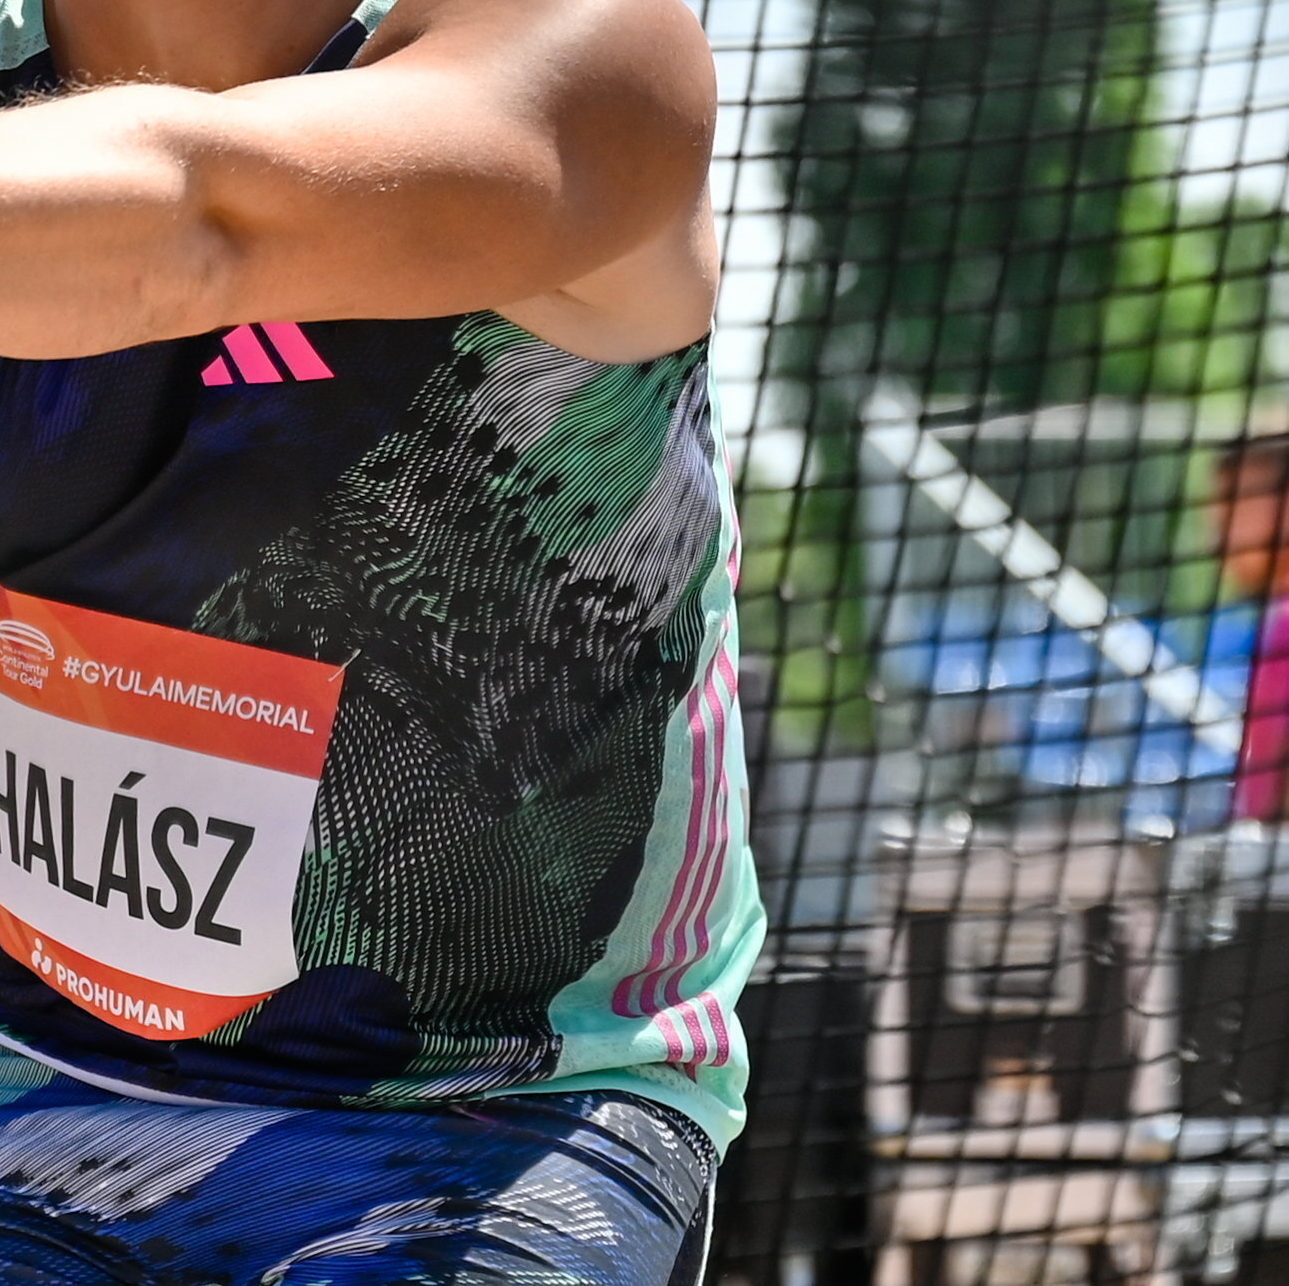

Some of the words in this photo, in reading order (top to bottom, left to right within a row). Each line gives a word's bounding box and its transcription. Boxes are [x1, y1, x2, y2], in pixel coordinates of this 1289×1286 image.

[19, 671, 44, 691] Gold
[62, 656, 315, 735] #GYULAIMEMORIAL
[55, 962, 186, 1032] PROHUMAN
